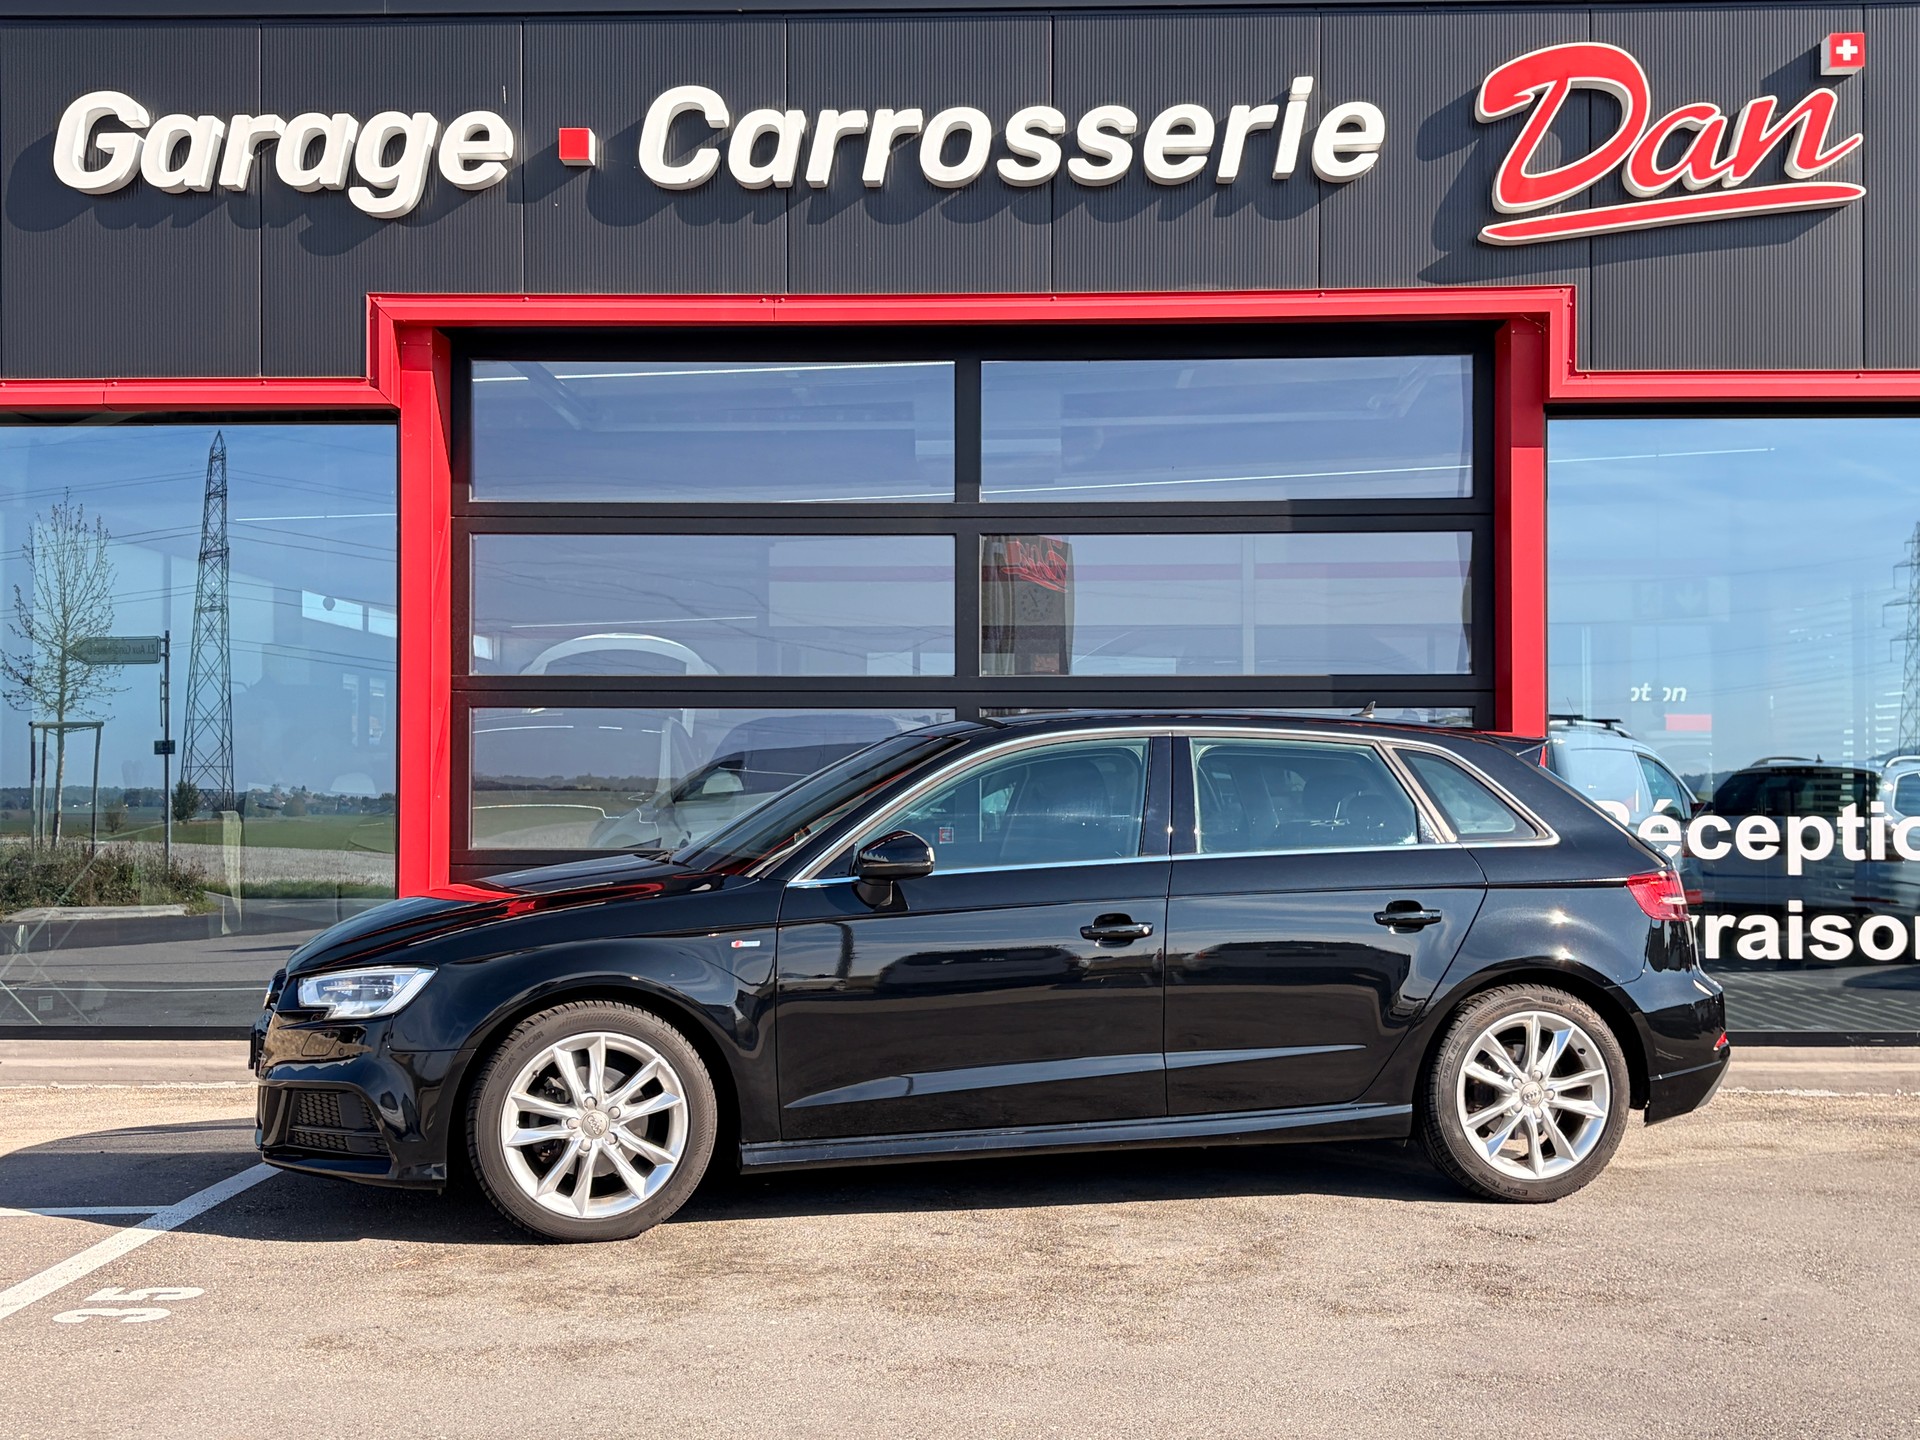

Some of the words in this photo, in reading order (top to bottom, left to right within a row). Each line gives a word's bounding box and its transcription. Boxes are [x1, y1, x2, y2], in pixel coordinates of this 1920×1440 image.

[53, 90, 515, 219] Garage
[638, 75, 1386, 190] Carrosserie
[1475, 41, 1864, 214] Dan
[1690, 900, 1920, 961] raiso
